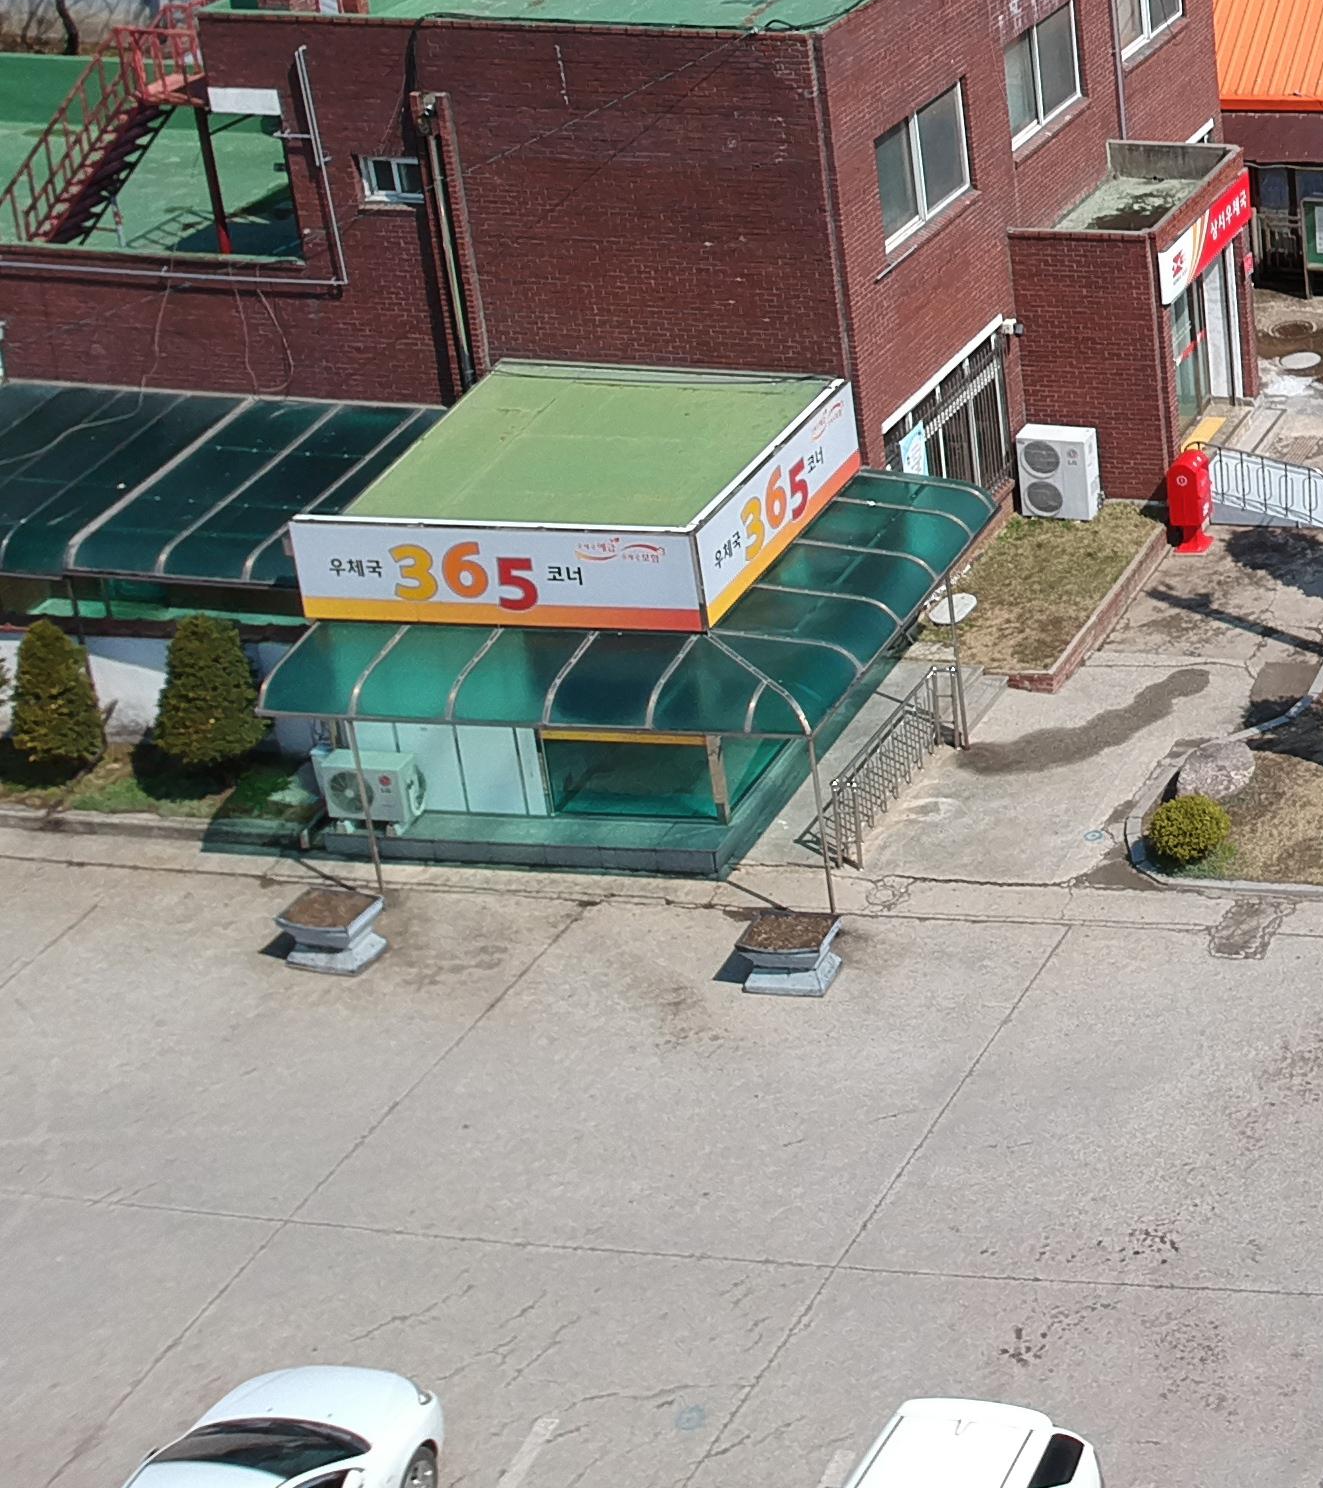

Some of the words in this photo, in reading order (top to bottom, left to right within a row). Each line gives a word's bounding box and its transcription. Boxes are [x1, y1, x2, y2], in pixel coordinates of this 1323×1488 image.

[1210, 189, 1247, 241] 상서우체국
[714, 531, 742, 569] 우체국
[741, 456, 809, 562] 365
[806, 446, 824, 475] 코너
[328, 558, 383, 579] 우체국
[388, 541, 539, 612] 365
[546, 565, 585, 586] 코너
